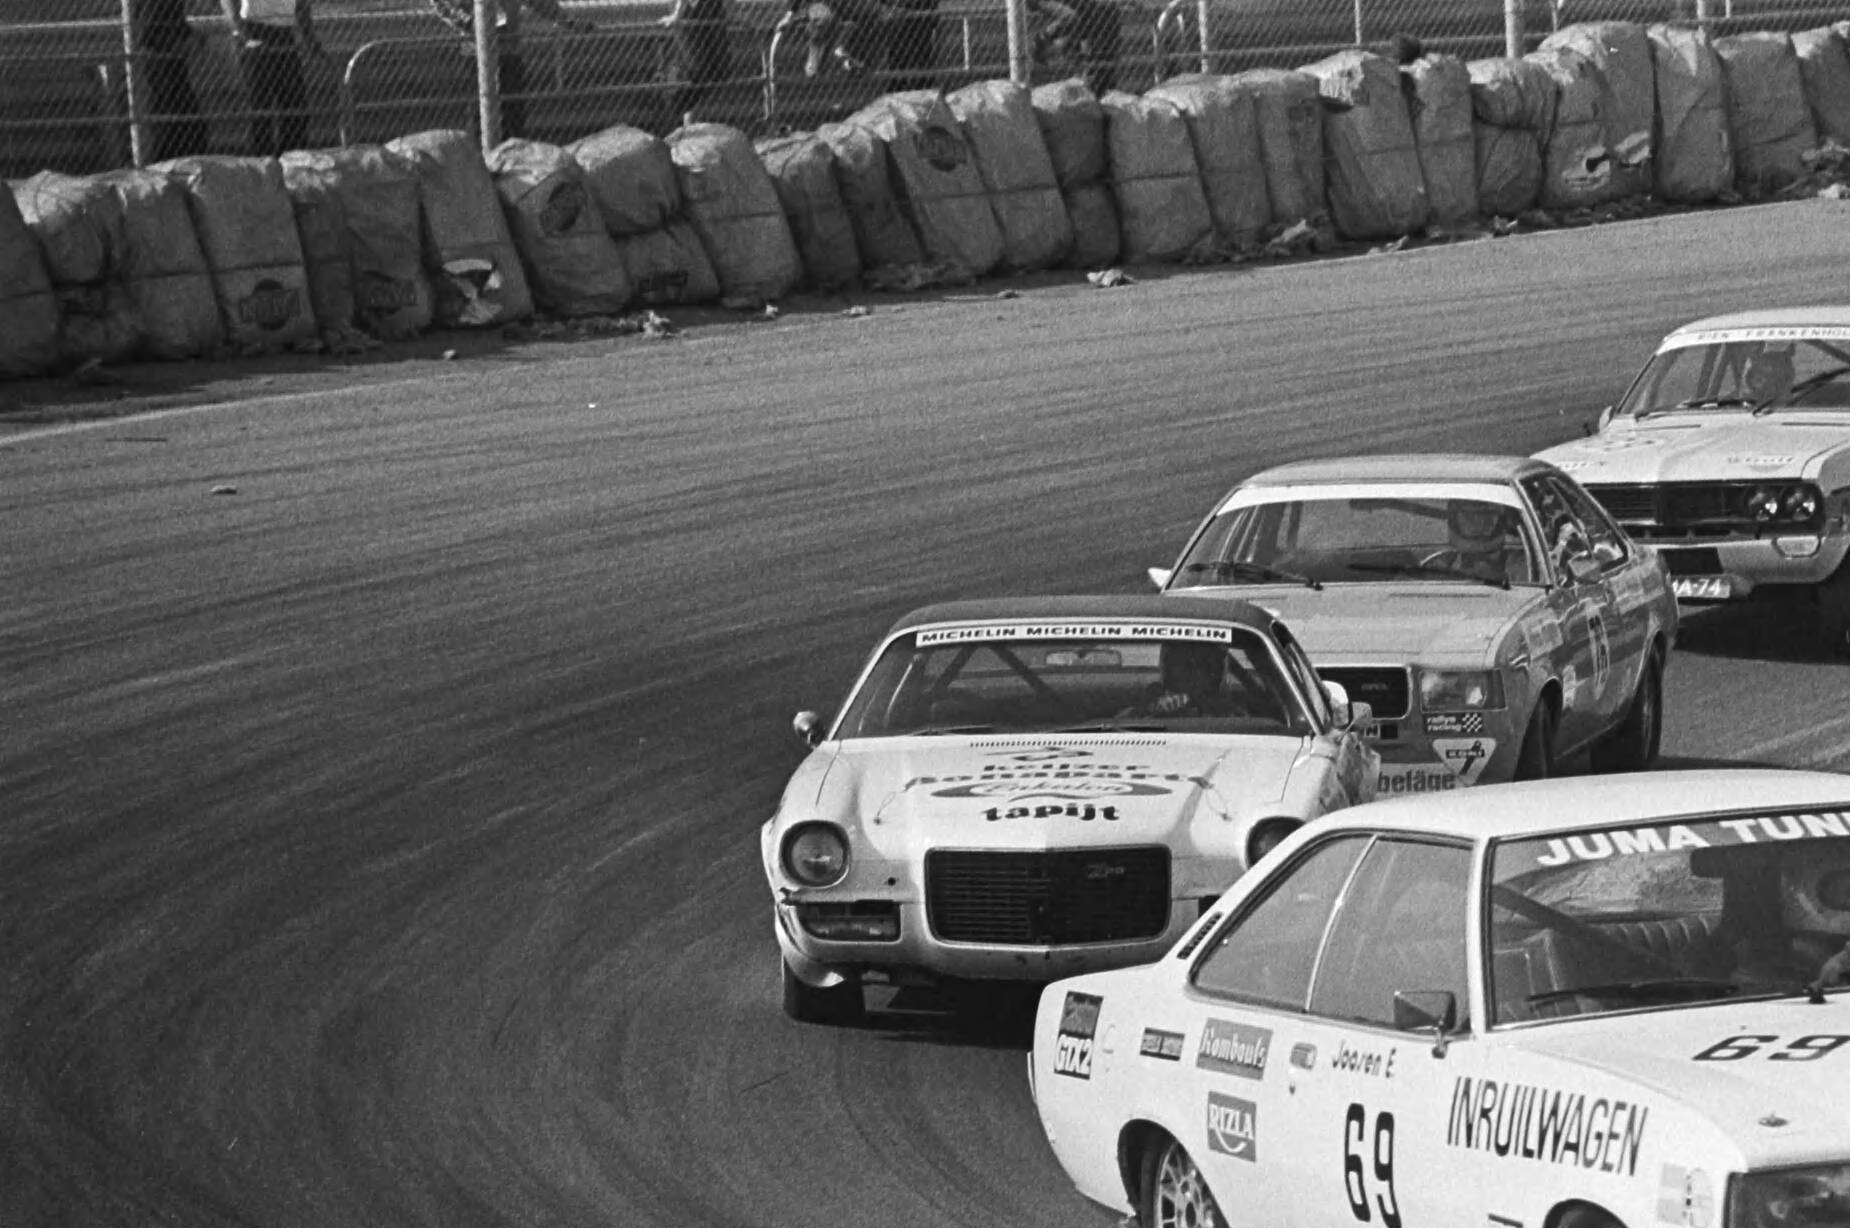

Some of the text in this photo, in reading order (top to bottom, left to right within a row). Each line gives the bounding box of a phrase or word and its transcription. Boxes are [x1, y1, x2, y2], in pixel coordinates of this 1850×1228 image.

[921, 626, 1228, 643] MICHELIN MICHELIN MICHELIN
[982, 802, 1120, 821] tapijt
[1536, 824, 1711, 867] JUMA
[1054, 1033, 1093, 1076] GTX2
[1199, 1027, 1267, 1068] Rombouts
[1208, 1102, 1255, 1141] RIZLA
[1447, 1076, 1649, 1177] INRUILWAGEN
